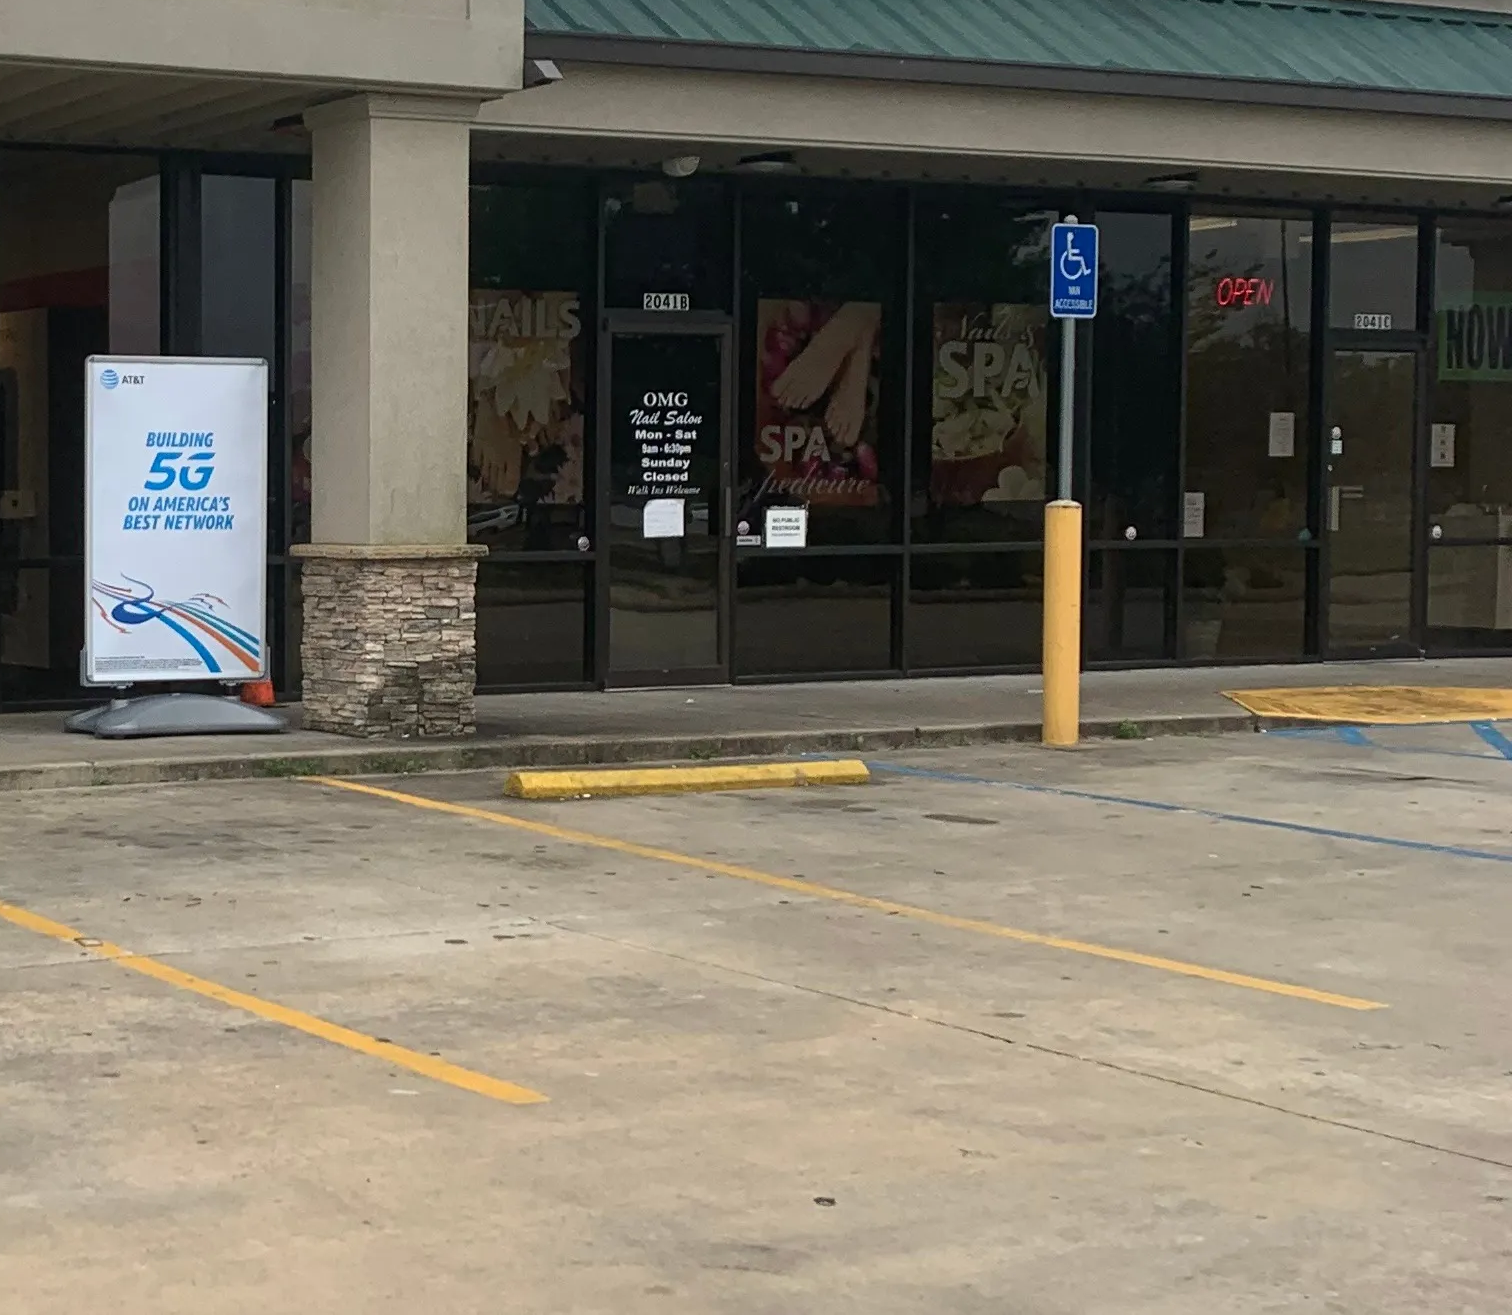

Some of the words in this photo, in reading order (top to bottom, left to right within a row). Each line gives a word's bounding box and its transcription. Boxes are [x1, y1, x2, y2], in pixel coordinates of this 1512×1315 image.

[1217, 277, 1275, 305] OPEN
[645, 294, 688, 309] 2041B
[938, 339, 1041, 398] SPA
[121, 375, 145, 385] AT&T
[643, 391, 689, 407] OMG
[629, 408, 661, 425] Nail
[664, 410, 703, 426] Salon
[146, 431, 214, 448] BUILDING
[635, 429, 663, 439] Mon
[675, 429, 697, 439] Sat
[759, 423, 832, 463] SPA
[144, 451, 216, 491] 5G
[641, 457, 691, 470] Sunday
[642, 471, 689, 482] Closed
[128, 496, 150, 512] ON
[153, 496, 231, 512] AMERICA'S
[123, 514, 162, 530] BEST
[164, 514, 235, 530] NETWORK
